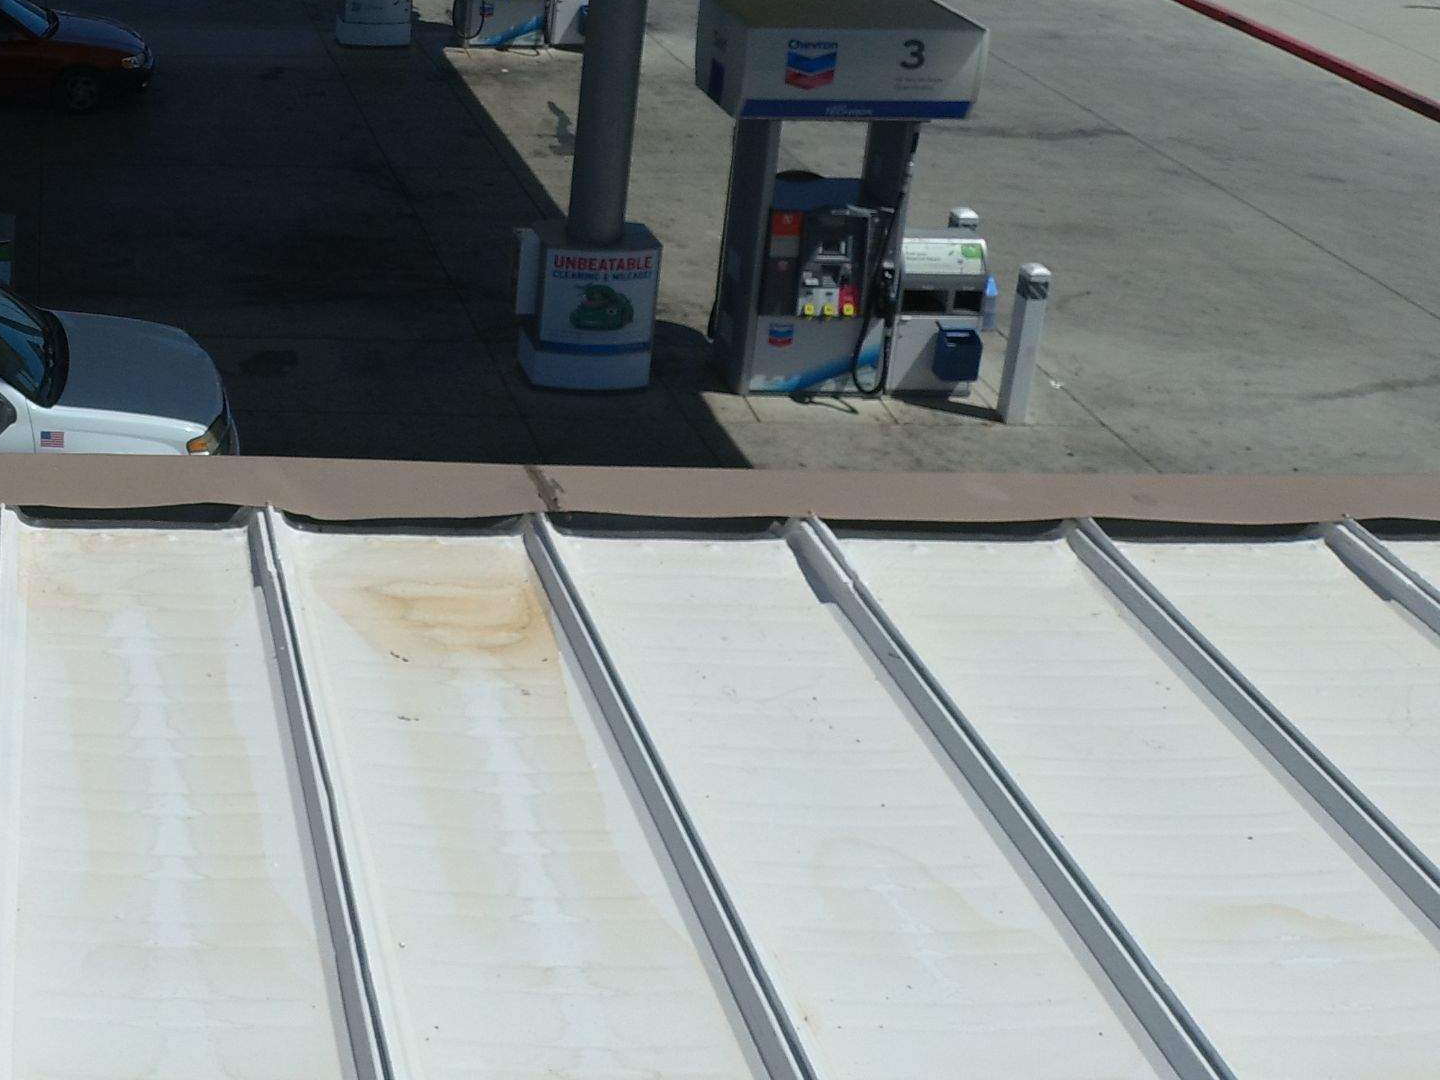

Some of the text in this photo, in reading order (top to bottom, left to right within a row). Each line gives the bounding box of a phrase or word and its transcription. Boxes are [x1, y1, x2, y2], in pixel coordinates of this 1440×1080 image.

[788, 39, 839, 49] Chevron
[900, 39, 926, 70] 3
[554, 255, 653, 271] UNBEATABLE
